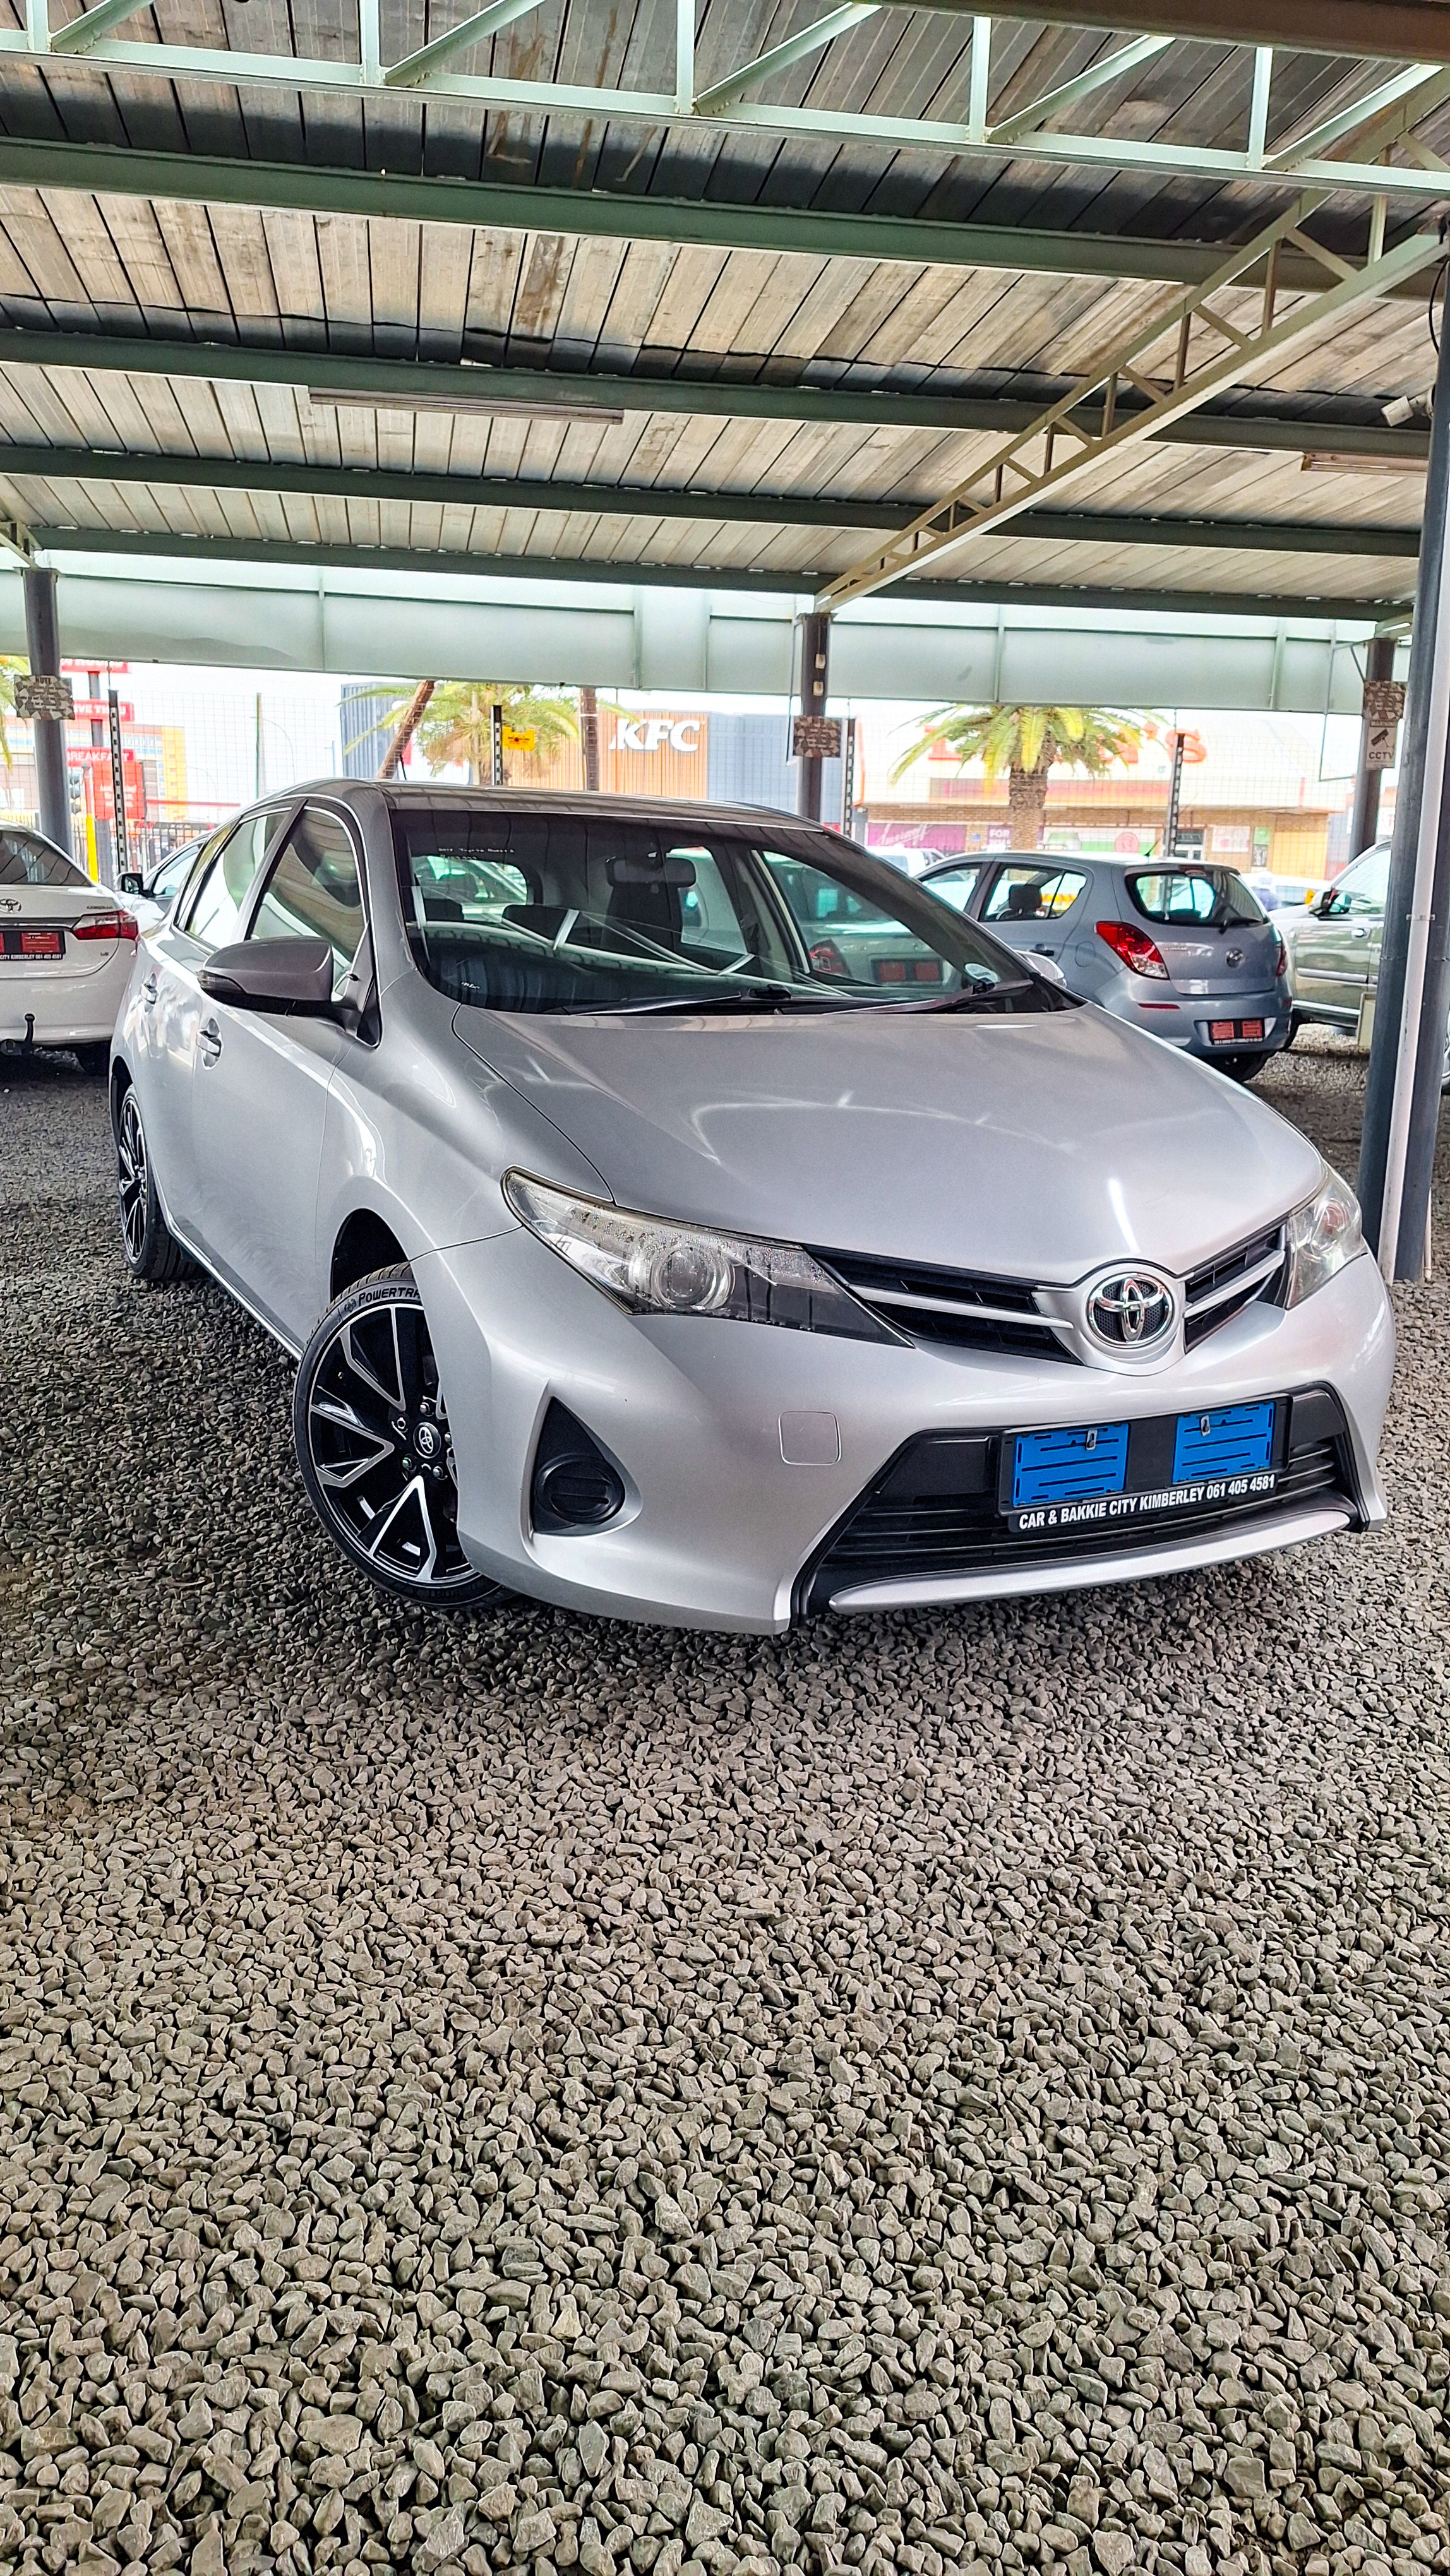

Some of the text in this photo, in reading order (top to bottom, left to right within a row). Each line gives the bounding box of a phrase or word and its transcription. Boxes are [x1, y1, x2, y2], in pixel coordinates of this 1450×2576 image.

[73, 704, 126, 715] IVE THU
[609, 719, 700, 751] KFC
[66, 751, 129, 761] BREAKFAT
[1369, 751, 1395, 760] CCTV
[990, 829, 1010, 838] FOR
[359, 1287, 421, 1306] POWERTRA
[1019, 1474, 1275, 1529] CAR & BAKKIE CITY KIMBERLEY 061 405 4581
